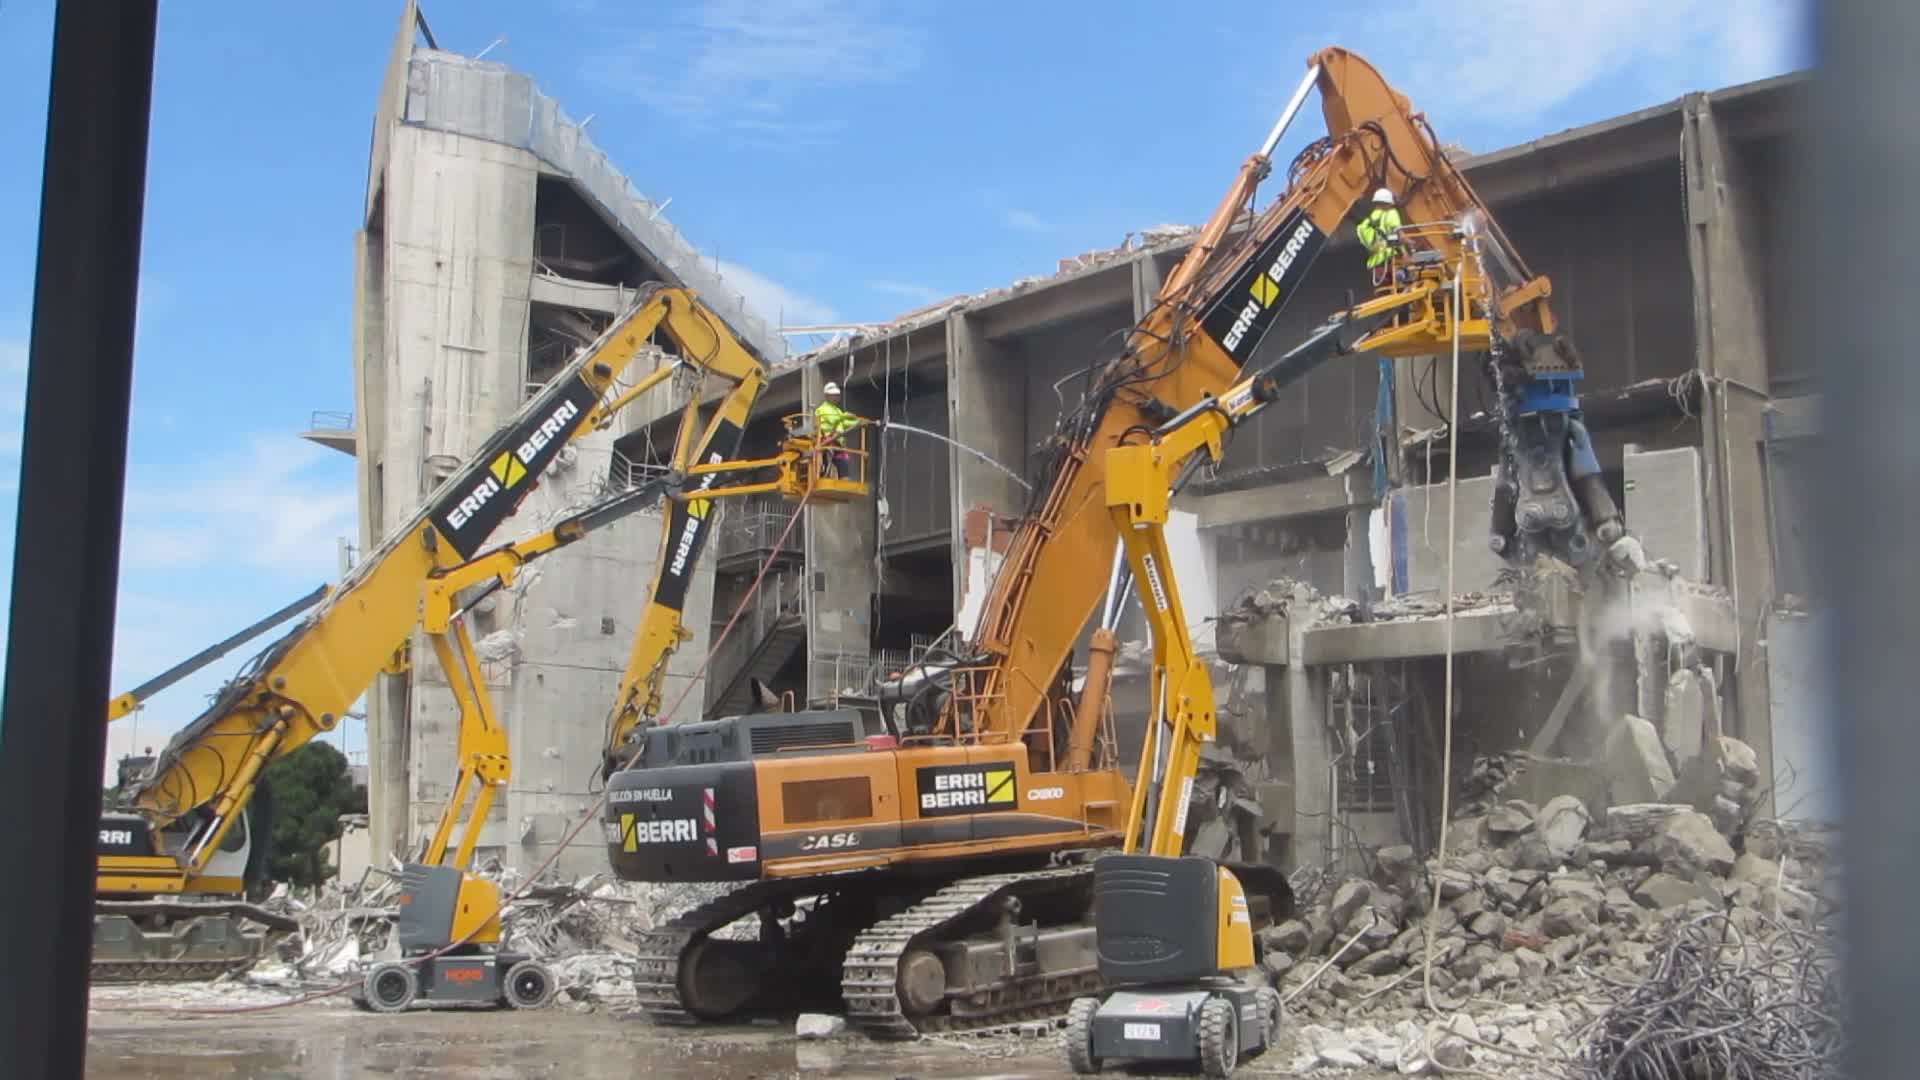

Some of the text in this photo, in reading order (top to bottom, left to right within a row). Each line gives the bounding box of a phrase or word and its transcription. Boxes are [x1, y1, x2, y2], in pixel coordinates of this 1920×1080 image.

[1222, 300, 1261, 352] ERRI
[1268, 219, 1314, 283] BERRI
[446, 400, 579, 530] ERRI BERRI
[670, 517, 699, 576] BERRI
[935, 772, 984, 790] ERRI
[921, 789, 985, 808] BERRI
[98, 830, 132, 844] RRI
[637, 818, 697, 843] BERRI
[801, 832, 860, 850] CASE
